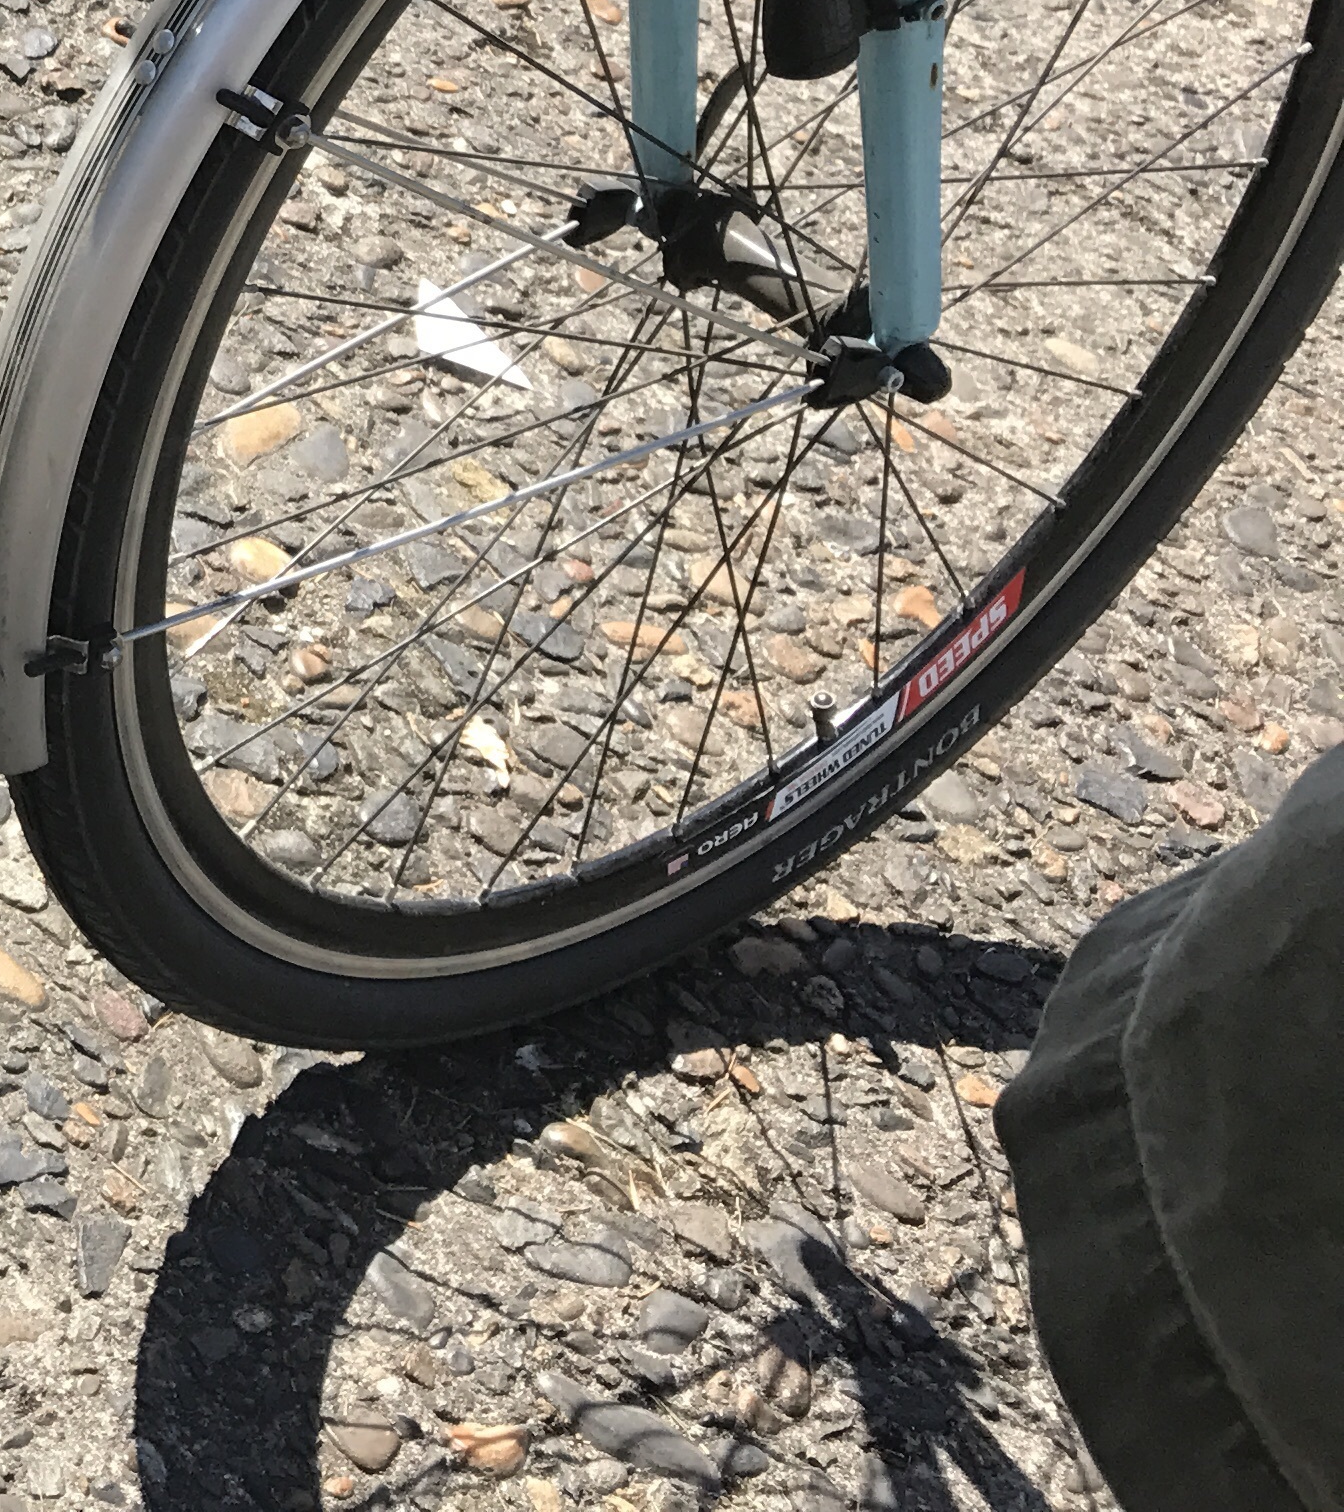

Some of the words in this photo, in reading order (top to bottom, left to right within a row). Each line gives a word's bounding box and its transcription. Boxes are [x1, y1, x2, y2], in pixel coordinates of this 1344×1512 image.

[918, 595, 1008, 697] SPEED
[842, 721, 887, 764] TUNED
[771, 703, 981, 884] BONTRAGER
[783, 759, 840, 811] WHEELS
[697, 811, 759, 856] AERO
